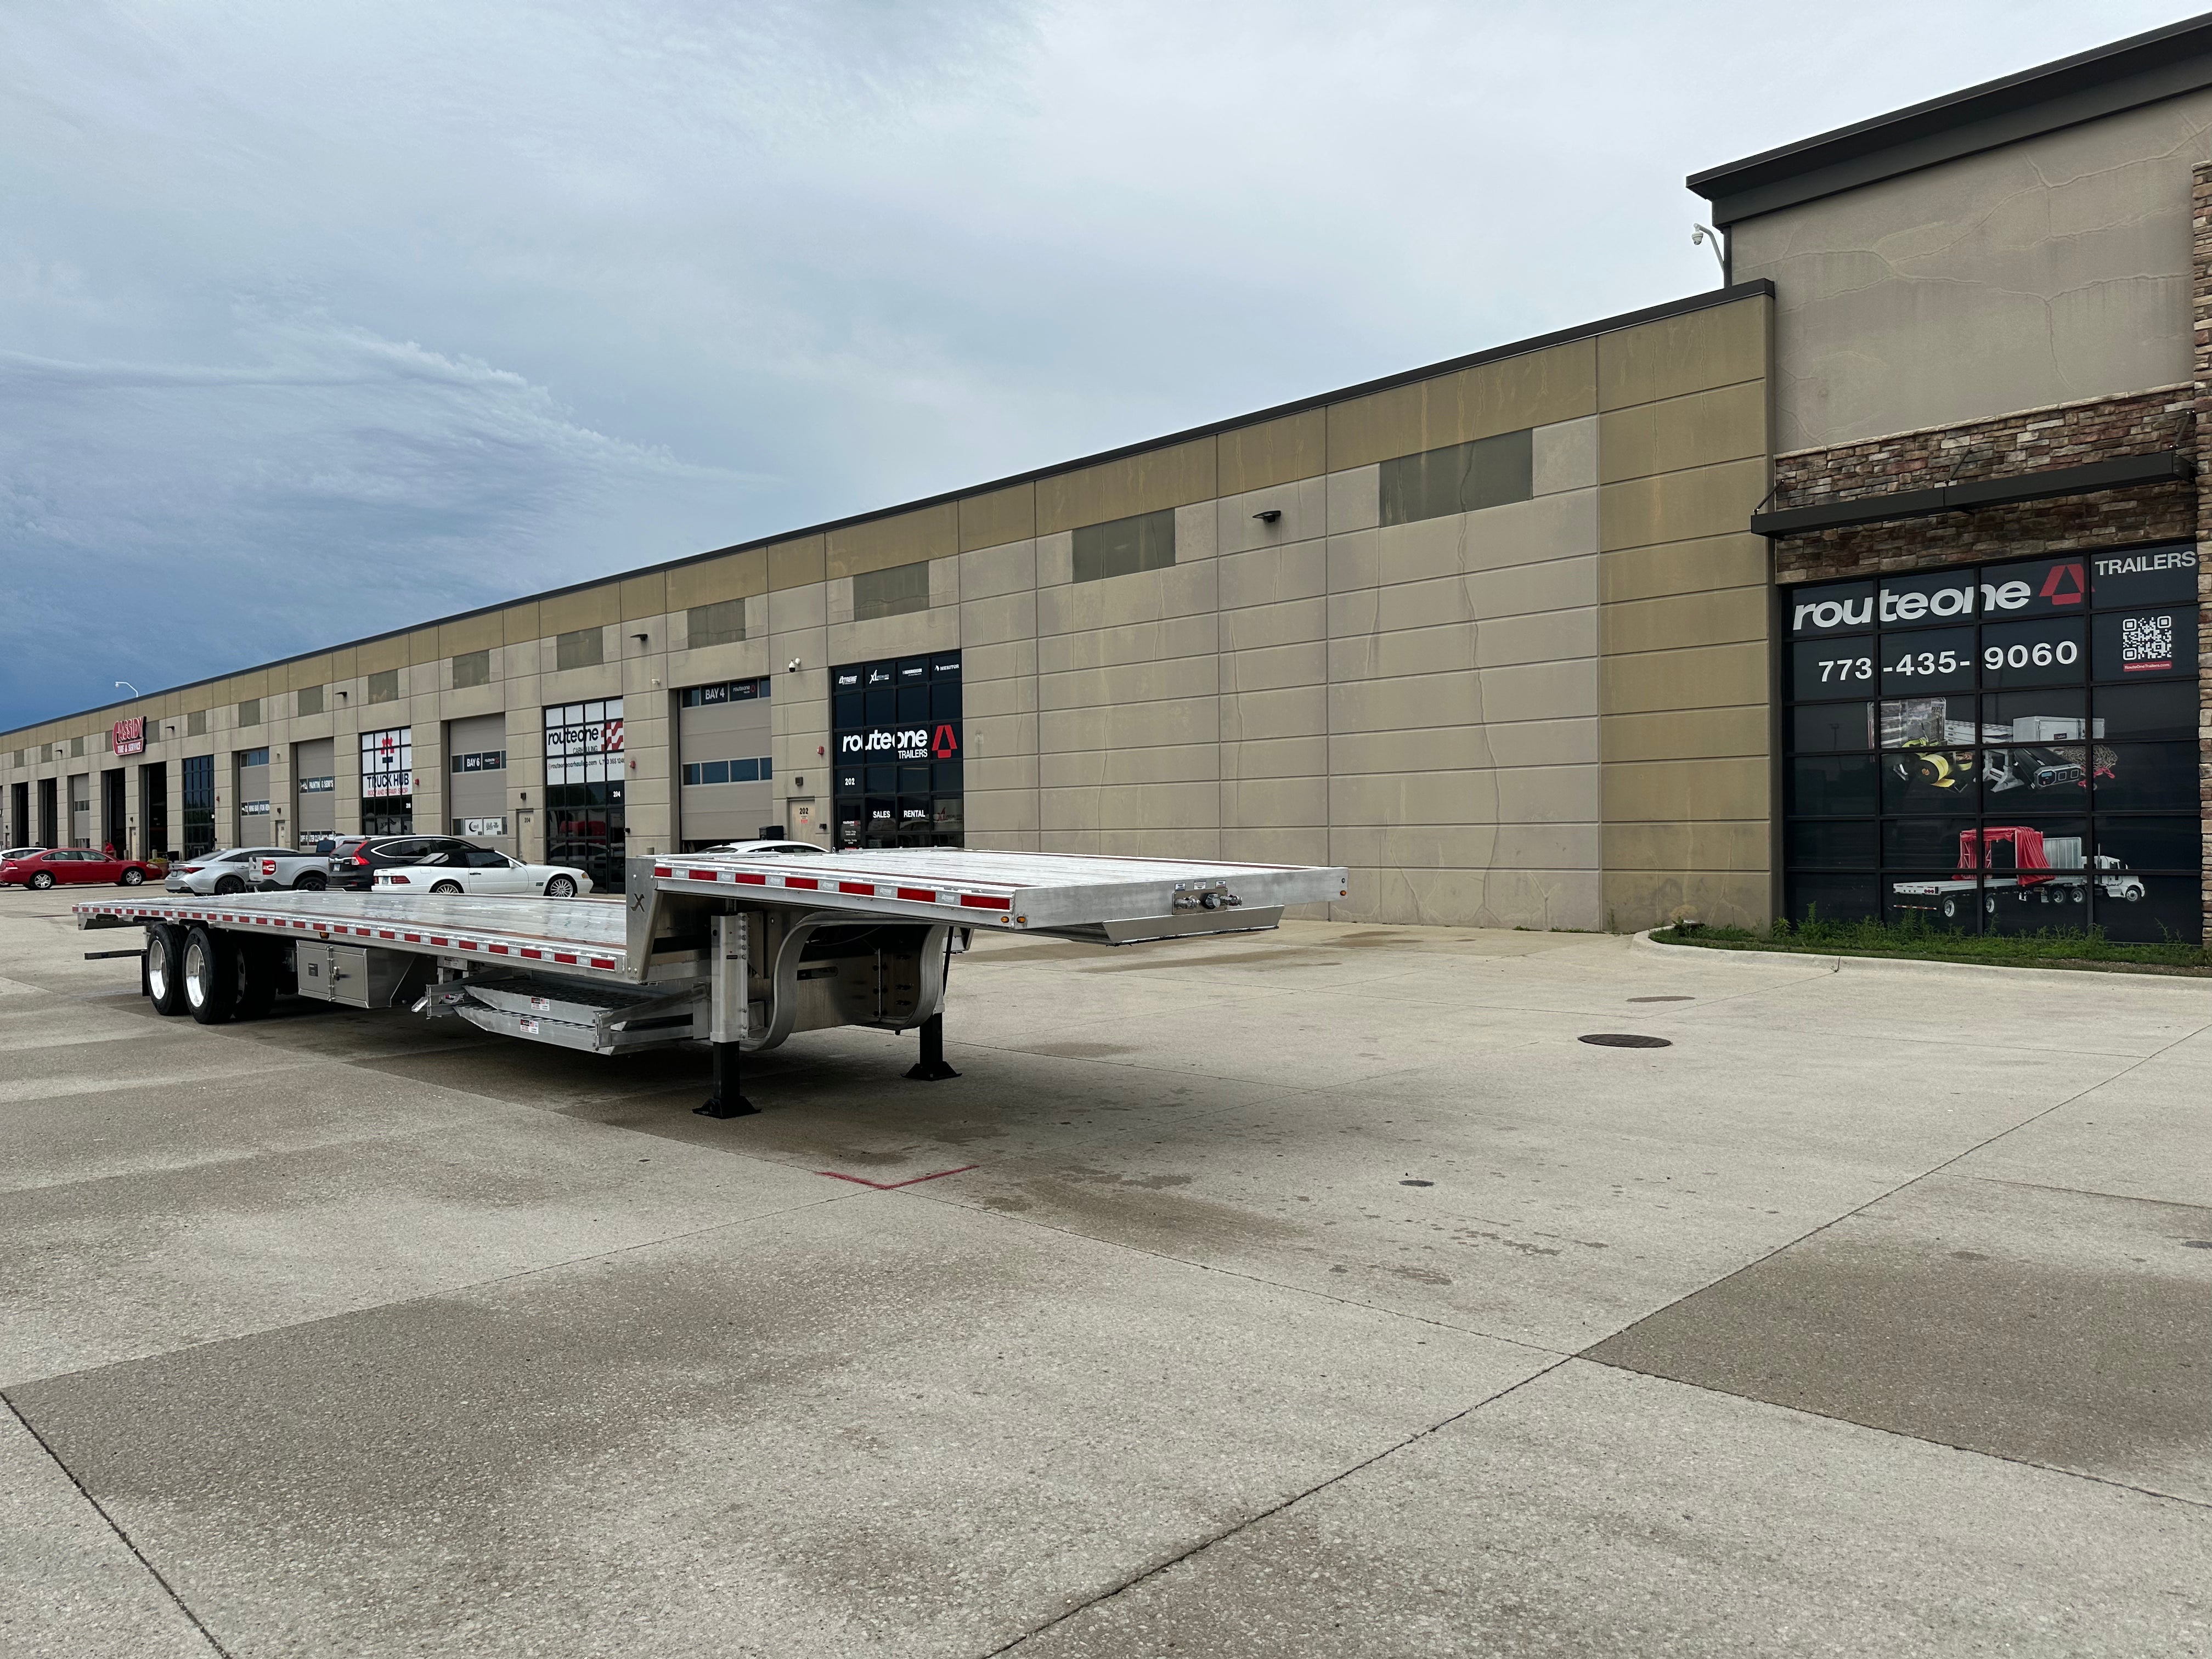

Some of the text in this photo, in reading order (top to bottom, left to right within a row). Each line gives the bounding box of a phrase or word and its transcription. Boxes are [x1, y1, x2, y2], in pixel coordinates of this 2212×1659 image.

[2095, 551, 2196, 576] TRAILERS
[1793, 580, 2031, 630] routeone
[706, 687, 725, 700] BAY 4
[112, 716, 144, 746] CASSIDY
[548, 727, 599, 746] routeone
[128, 741, 141, 752] SERVICE
[843, 729, 928, 752] routeone
[898, 748, 928, 759] TRAILERS
[466, 757, 481, 768] BAY 6
[367, 772, 409, 788] TRUCK HUB
[845, 777, 855, 786] 202
[872, 809, 926, 819] SALES RENTAL
